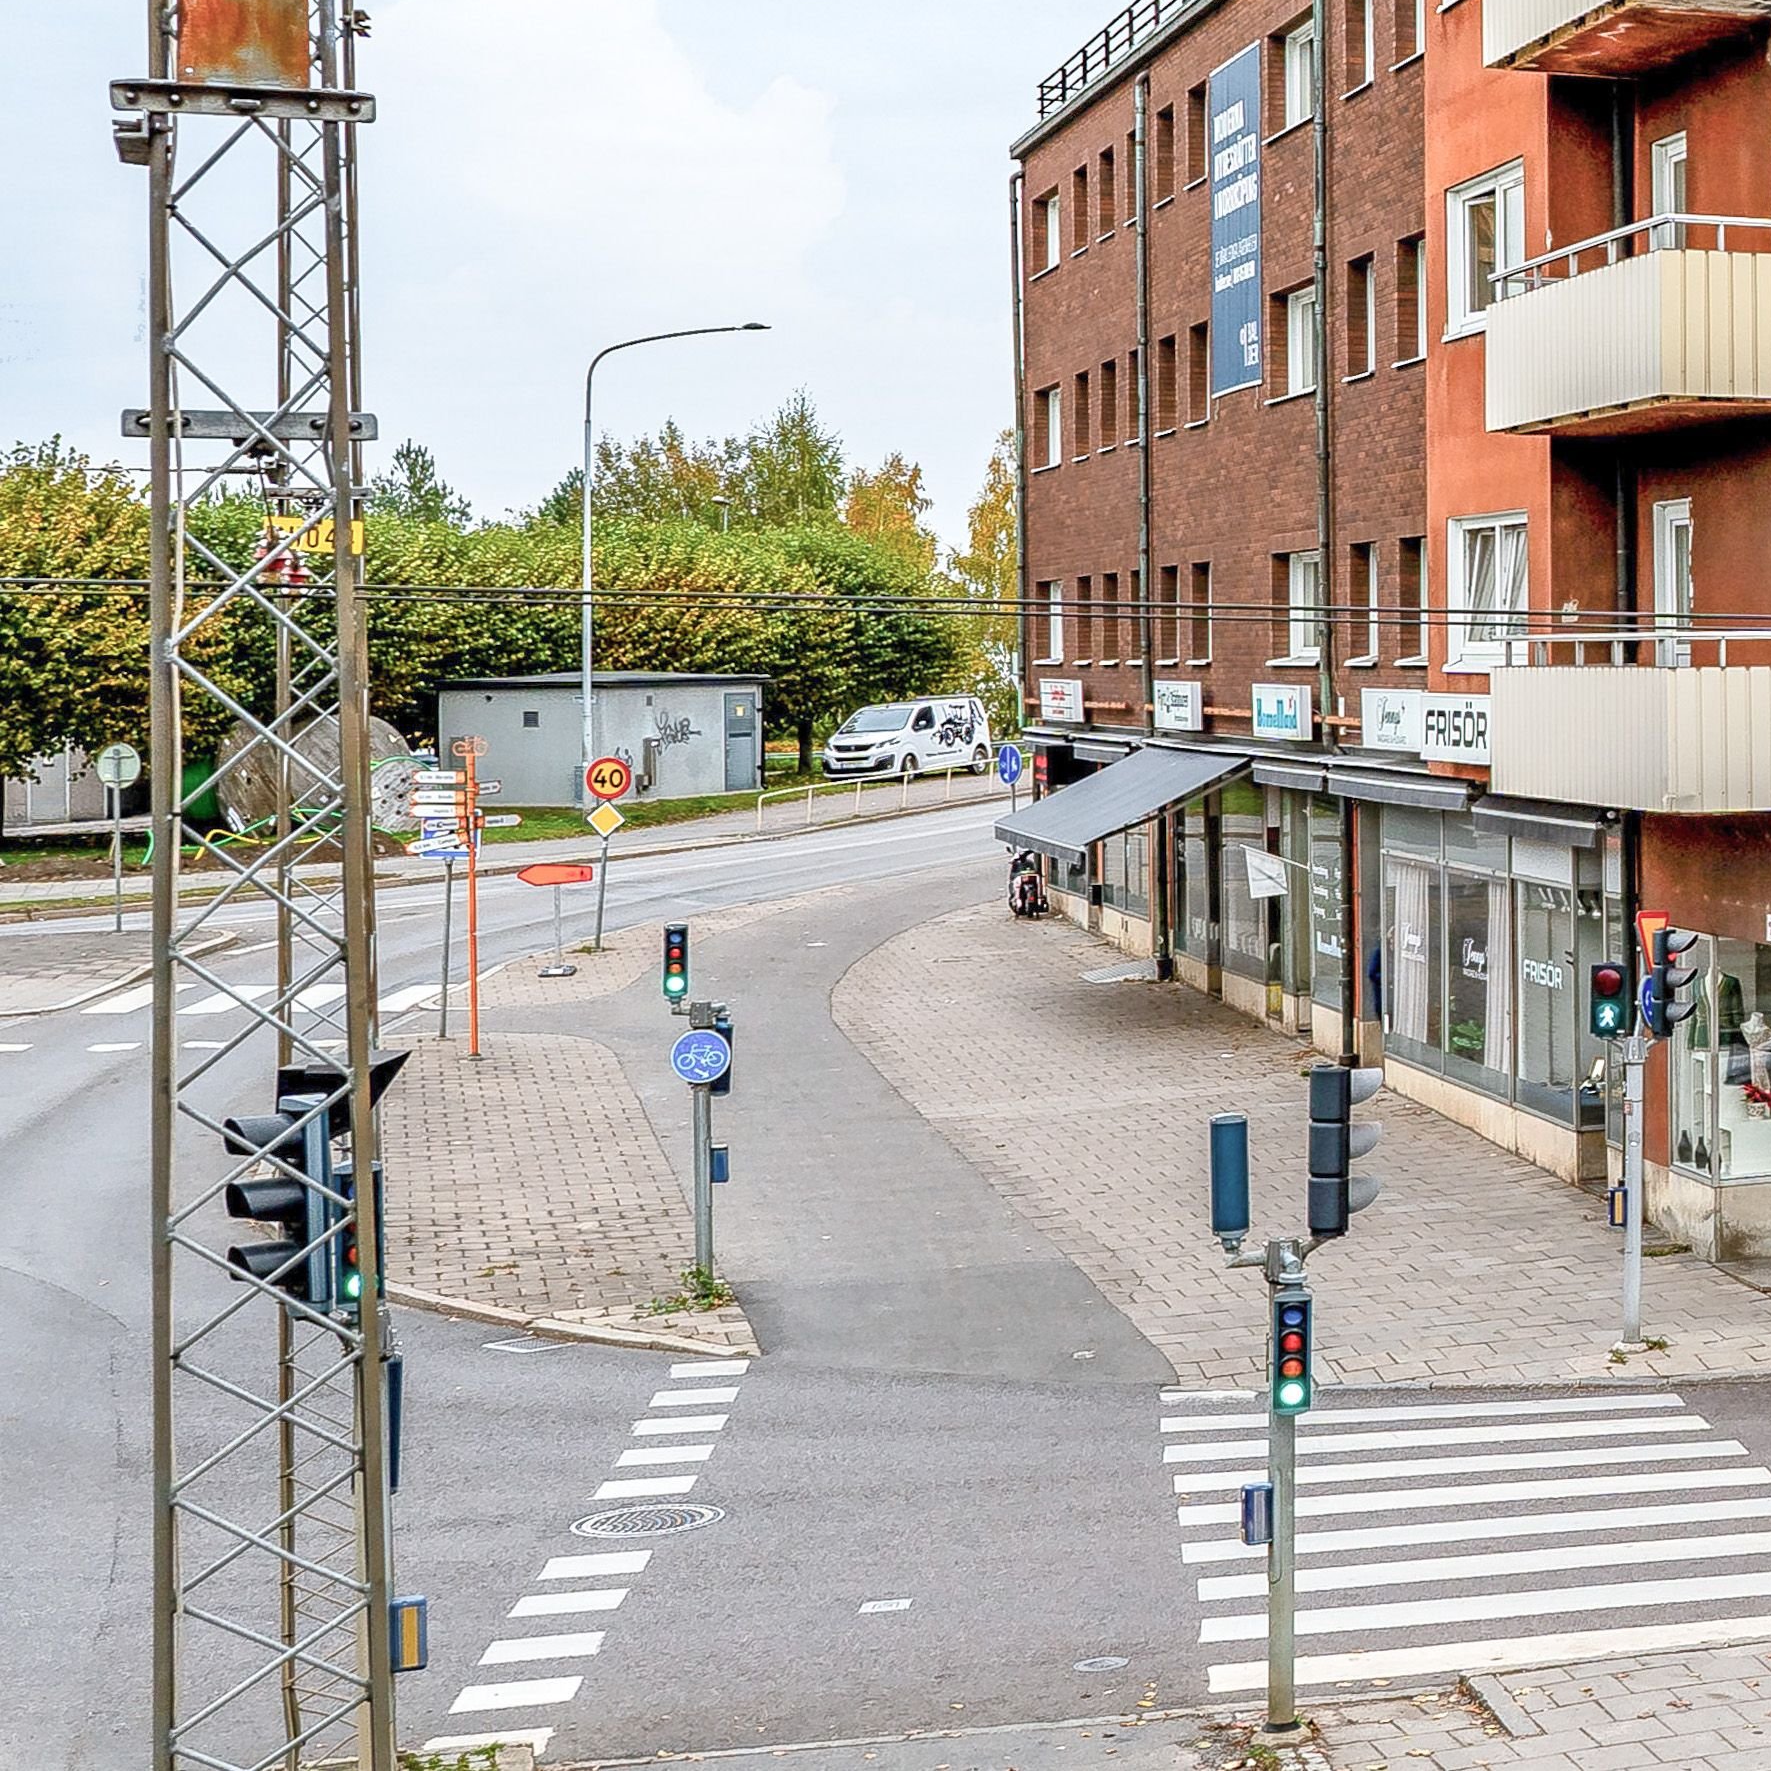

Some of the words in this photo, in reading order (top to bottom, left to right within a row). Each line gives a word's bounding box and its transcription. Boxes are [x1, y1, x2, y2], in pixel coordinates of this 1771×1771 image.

[1425, 701, 1487, 750] FRISÖR
[592, 768, 625, 789] 40
[1522, 959, 1563, 990] FRISÖR
